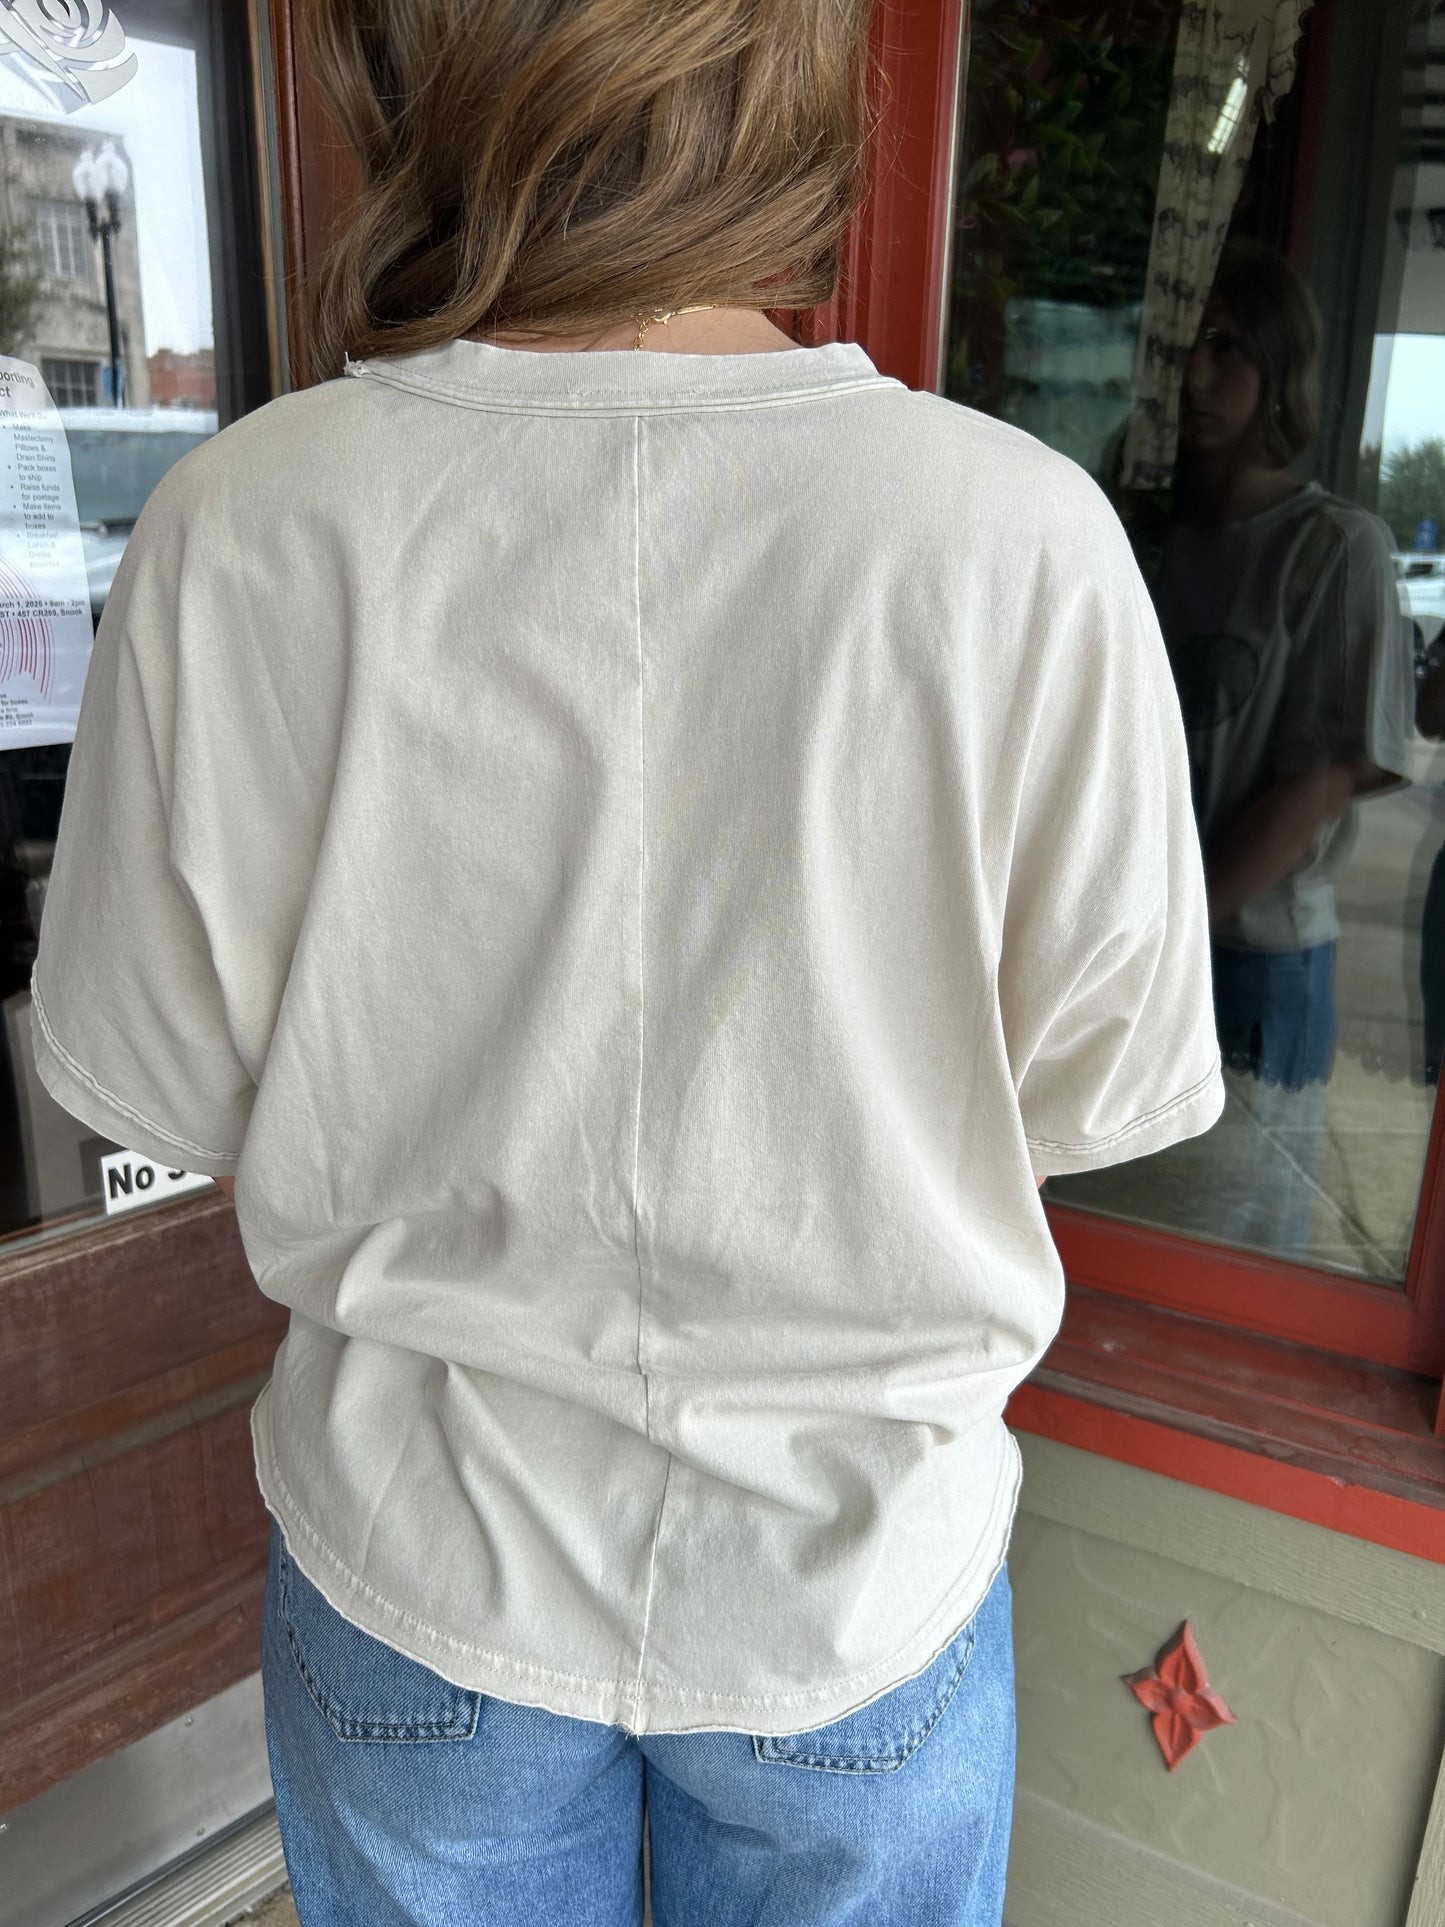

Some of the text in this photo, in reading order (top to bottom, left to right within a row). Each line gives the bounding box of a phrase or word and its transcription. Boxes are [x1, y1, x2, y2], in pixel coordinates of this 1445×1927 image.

[14, 433, 54, 445] Mastectomy
[15, 443, 46, 453] Pillows &
[16, 453, 36, 462] Drain
[18, 463, 57, 473] Pack boxes
[19, 473, 42, 483] to ship
[20, 483, 60, 492] Raise funds
[21, 492, 60, 503] for postage
[23, 503, 42, 511] Make
[24, 512, 54, 521] to add to
[25, 521, 46, 530] boxes
[25, 599, 43, 608] 2025
[108, 1162, 156, 1199] No
